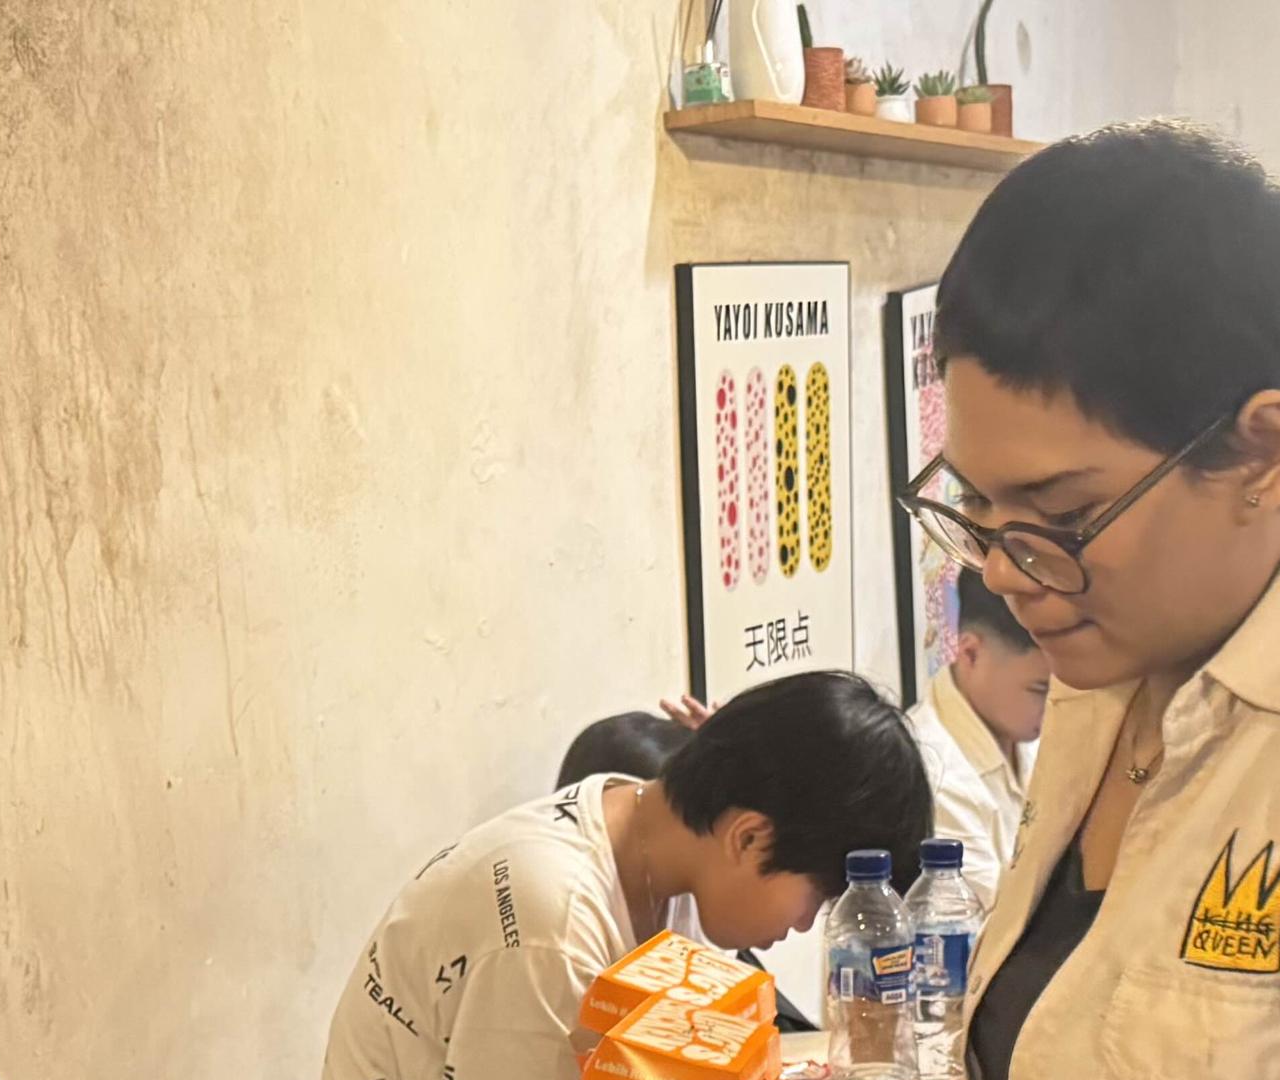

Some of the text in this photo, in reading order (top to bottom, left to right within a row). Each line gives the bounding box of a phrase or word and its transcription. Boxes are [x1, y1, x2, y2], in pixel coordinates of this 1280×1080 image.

[714, 300, 829, 341] YAYOI KUSAMA
[493, 859, 520, 948] LOS ANGELES
[1193, 929, 1278, 959] QUEEN
